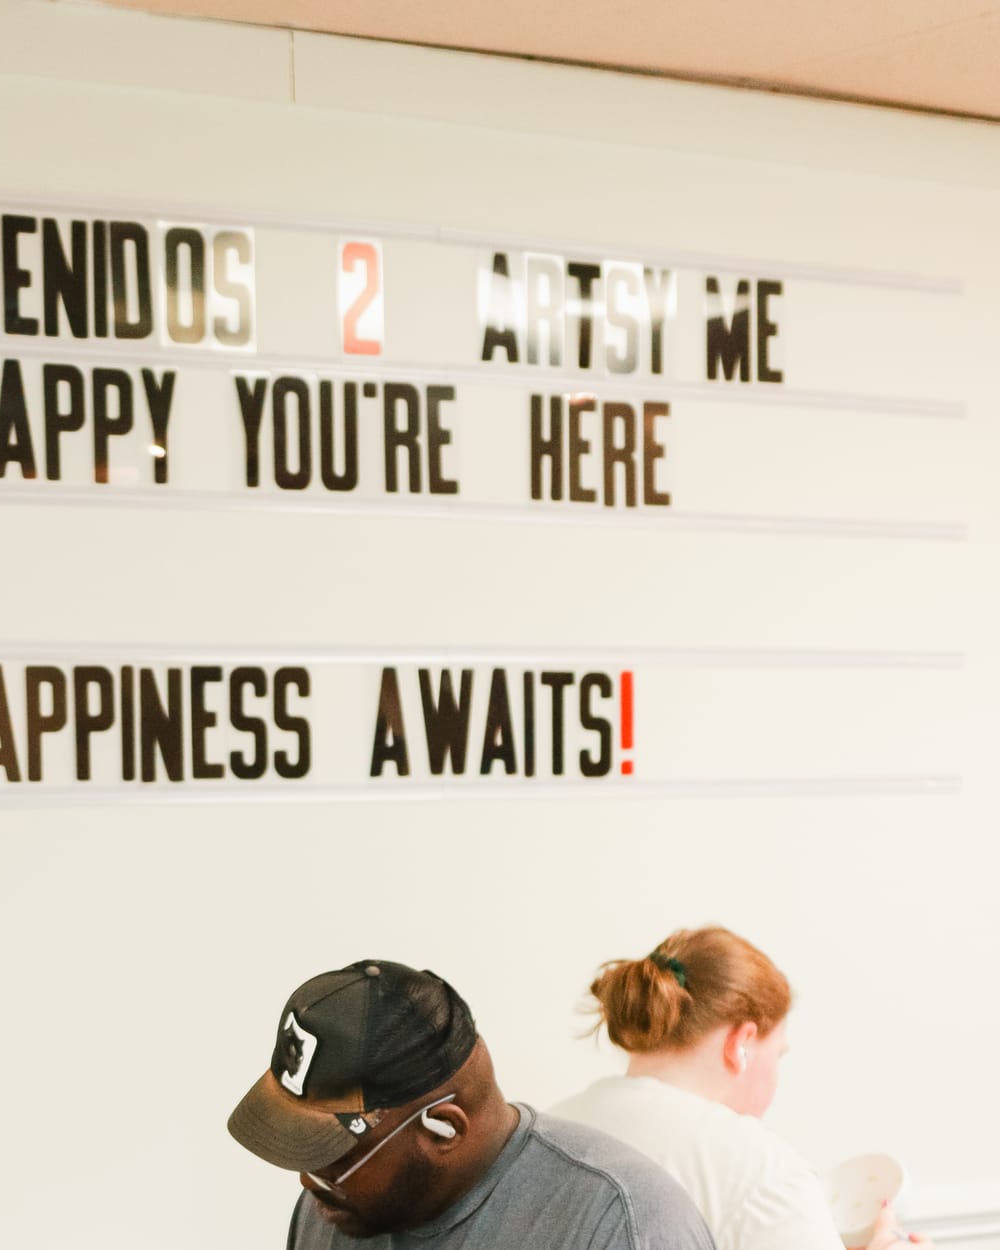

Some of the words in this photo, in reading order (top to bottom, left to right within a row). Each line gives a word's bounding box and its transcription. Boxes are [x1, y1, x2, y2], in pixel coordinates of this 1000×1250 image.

[342, 242, 381, 355] 2
[481, 252, 673, 376] ARTSY
[706, 276, 784, 383] ME
[234, 376, 459, 495] YOU'RE
[530, 394, 671, 508] HERE
[370, 667, 635, 778] AWAITS!
